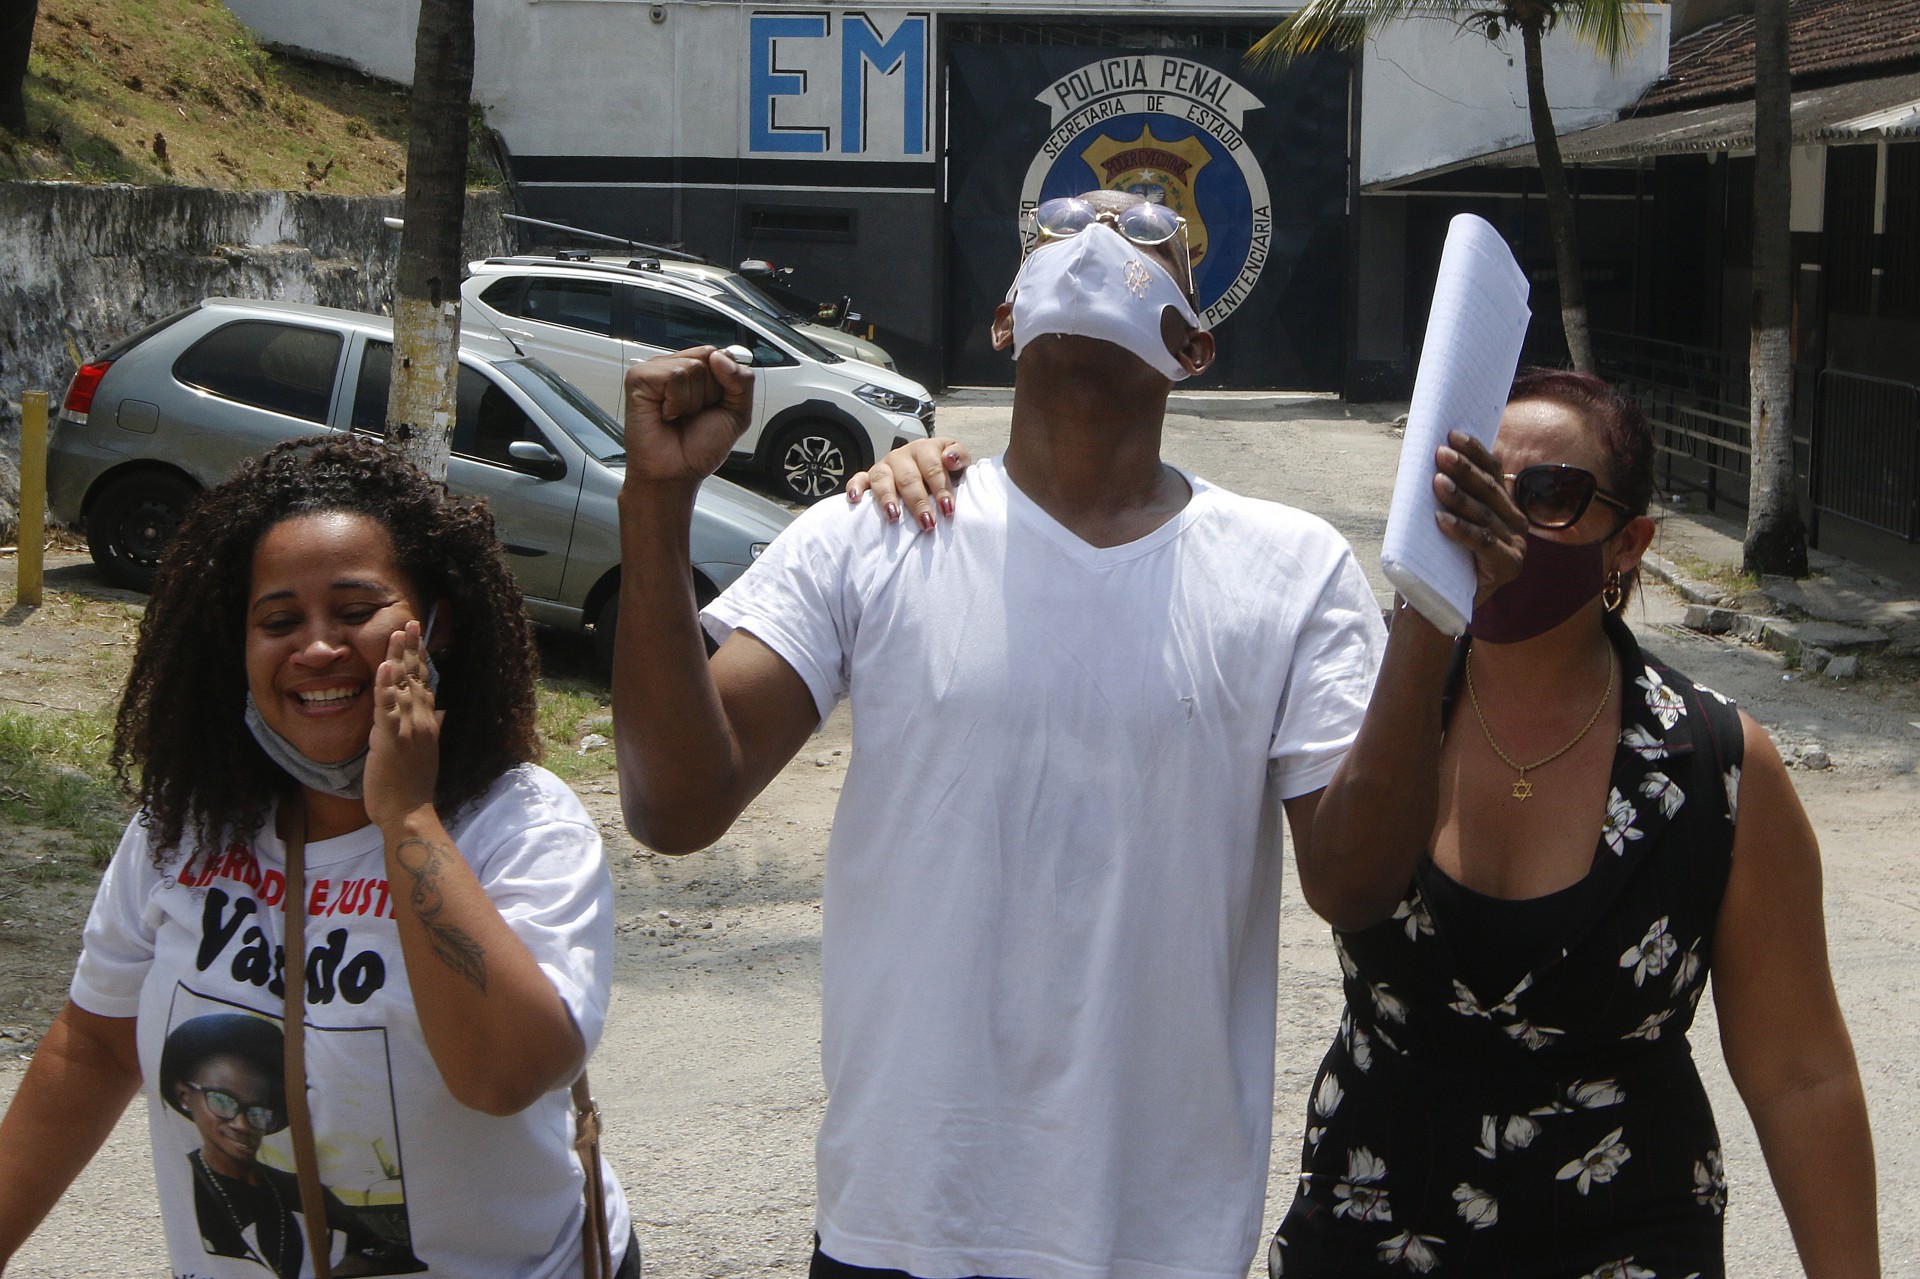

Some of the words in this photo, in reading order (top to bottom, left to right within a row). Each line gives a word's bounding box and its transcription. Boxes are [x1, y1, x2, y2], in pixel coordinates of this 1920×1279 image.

[749, 11, 930, 154] EM
[1160, 59, 1233, 112] PENAL
[1043, 98, 1126, 160] SECRETARIA
[1147, 96, 1165, 112] DE
[1186, 104, 1243, 152] ESTADO
[1205, 205, 1270, 325] PENITENCIARIA
[326, 878, 397, 919] JUST
